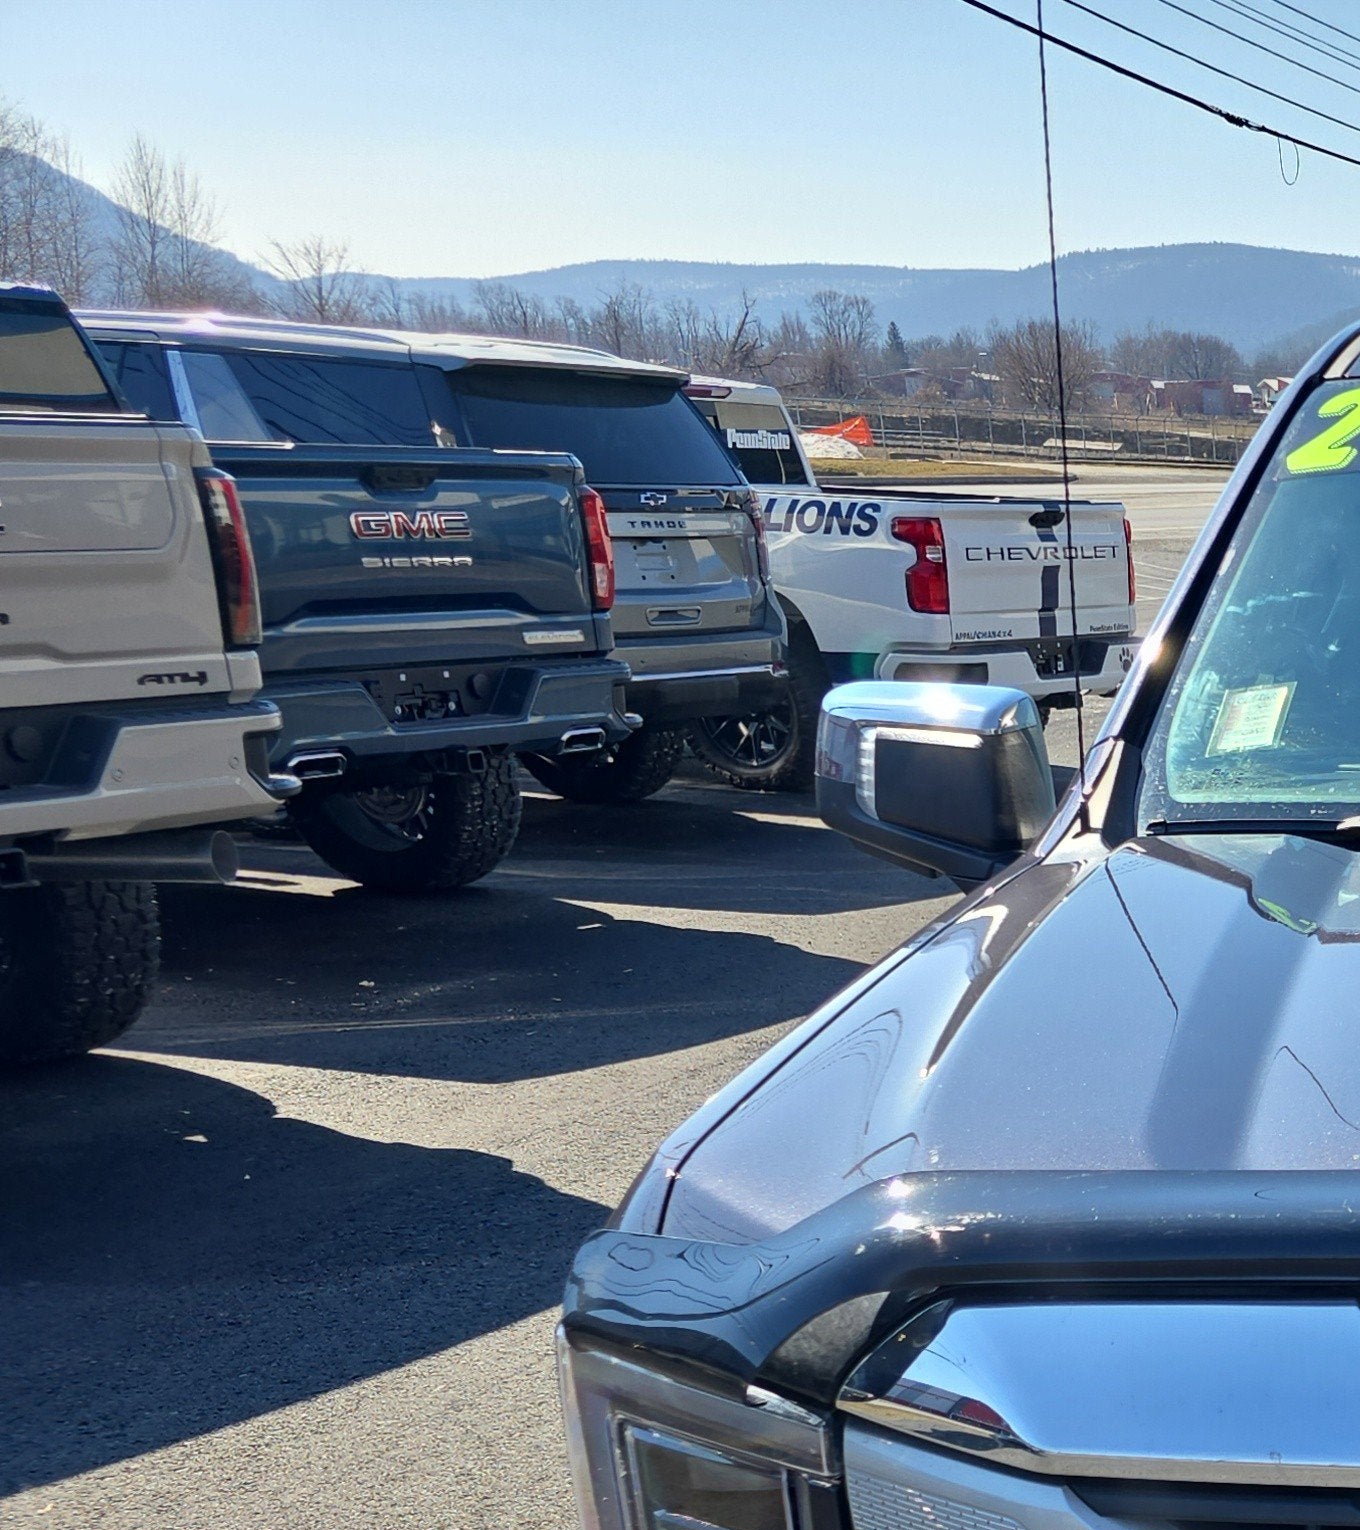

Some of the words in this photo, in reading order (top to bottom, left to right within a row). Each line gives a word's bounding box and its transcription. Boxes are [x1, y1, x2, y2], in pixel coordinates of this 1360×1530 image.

[350, 511, 472, 540] GMC
[627, 520, 686, 529] TAHOE
[763, 498, 882, 537] LIONS
[965, 545, 1119, 561] CHEVROLET
[361, 556, 473, 567] SIERRA
[137, 670, 208, 686] AT4
